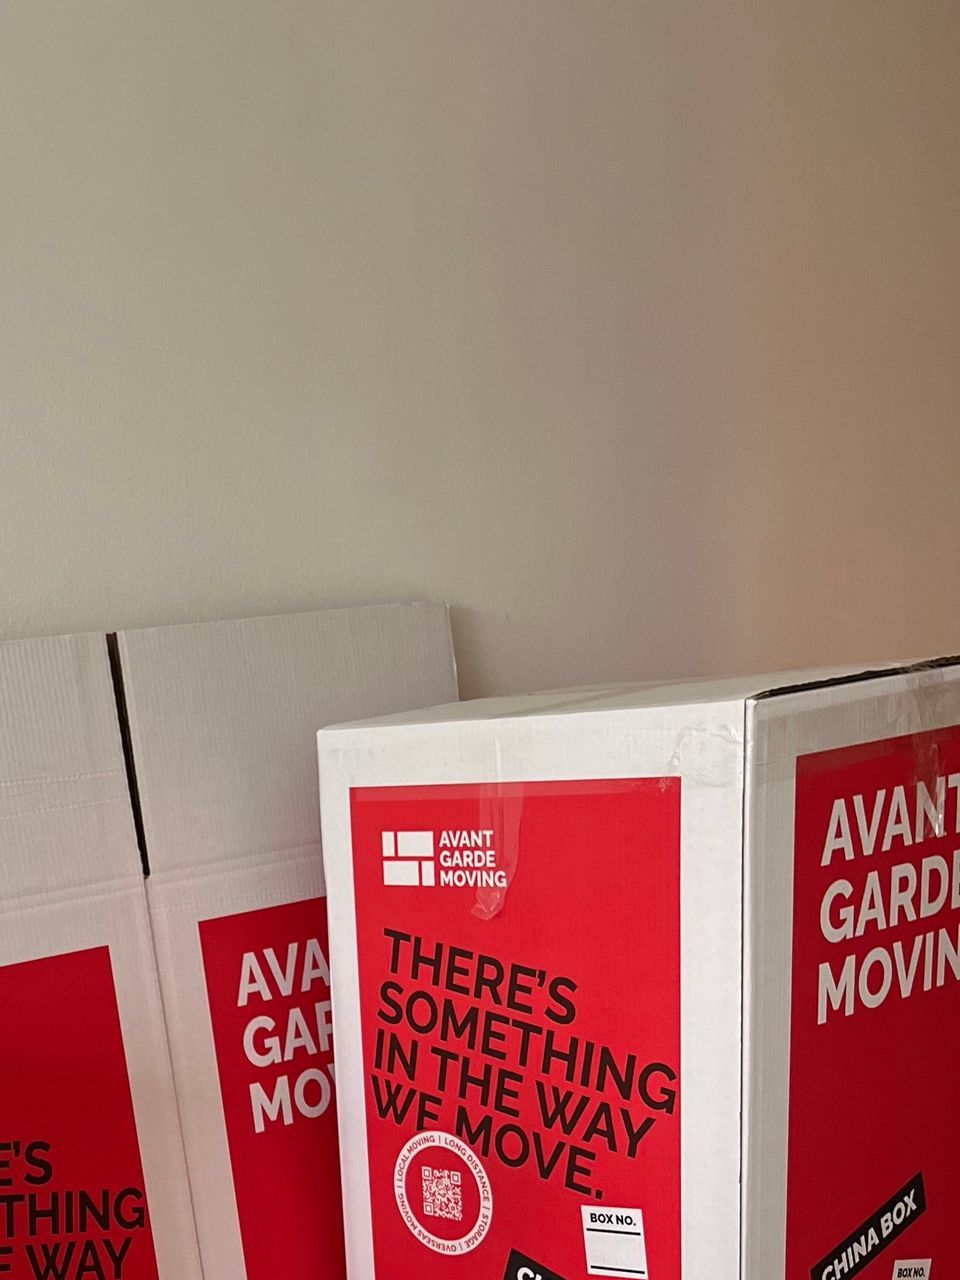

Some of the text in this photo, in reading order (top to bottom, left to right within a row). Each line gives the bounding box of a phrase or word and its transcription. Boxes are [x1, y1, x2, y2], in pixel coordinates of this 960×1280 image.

[439, 830, 493, 848] AVANT
[440, 850, 496, 868] GARDE
[440, 870, 507, 888] MOVING
[237, 938, 331, 1007] AVA
[383, 928, 578, 1024] THERE'S
[817, 924, 960, 1025] MOVIN
[243, 1000, 333, 1068] GA
[377, 980, 677, 1114] SOMETHING
[249, 1063, 336, 1134] MO
[375, 1028, 655, 1159] IN THE WAY
[371, 1073, 603, 1200] WE MOVE.
[397, 1135, 436, 1182] LOCAL MOVING
[444, 1137, 490, 1203] LONG DISTANCE
[397, 1193, 457, 1252] OVERSEAS MOVING
[464, 1214, 489, 1248] STORAGE
[589, 1212, 637, 1227] BOX NO.
[880, 1188, 917, 1238] BOX
[896, 1266, 925, 1279] BOX NO.
